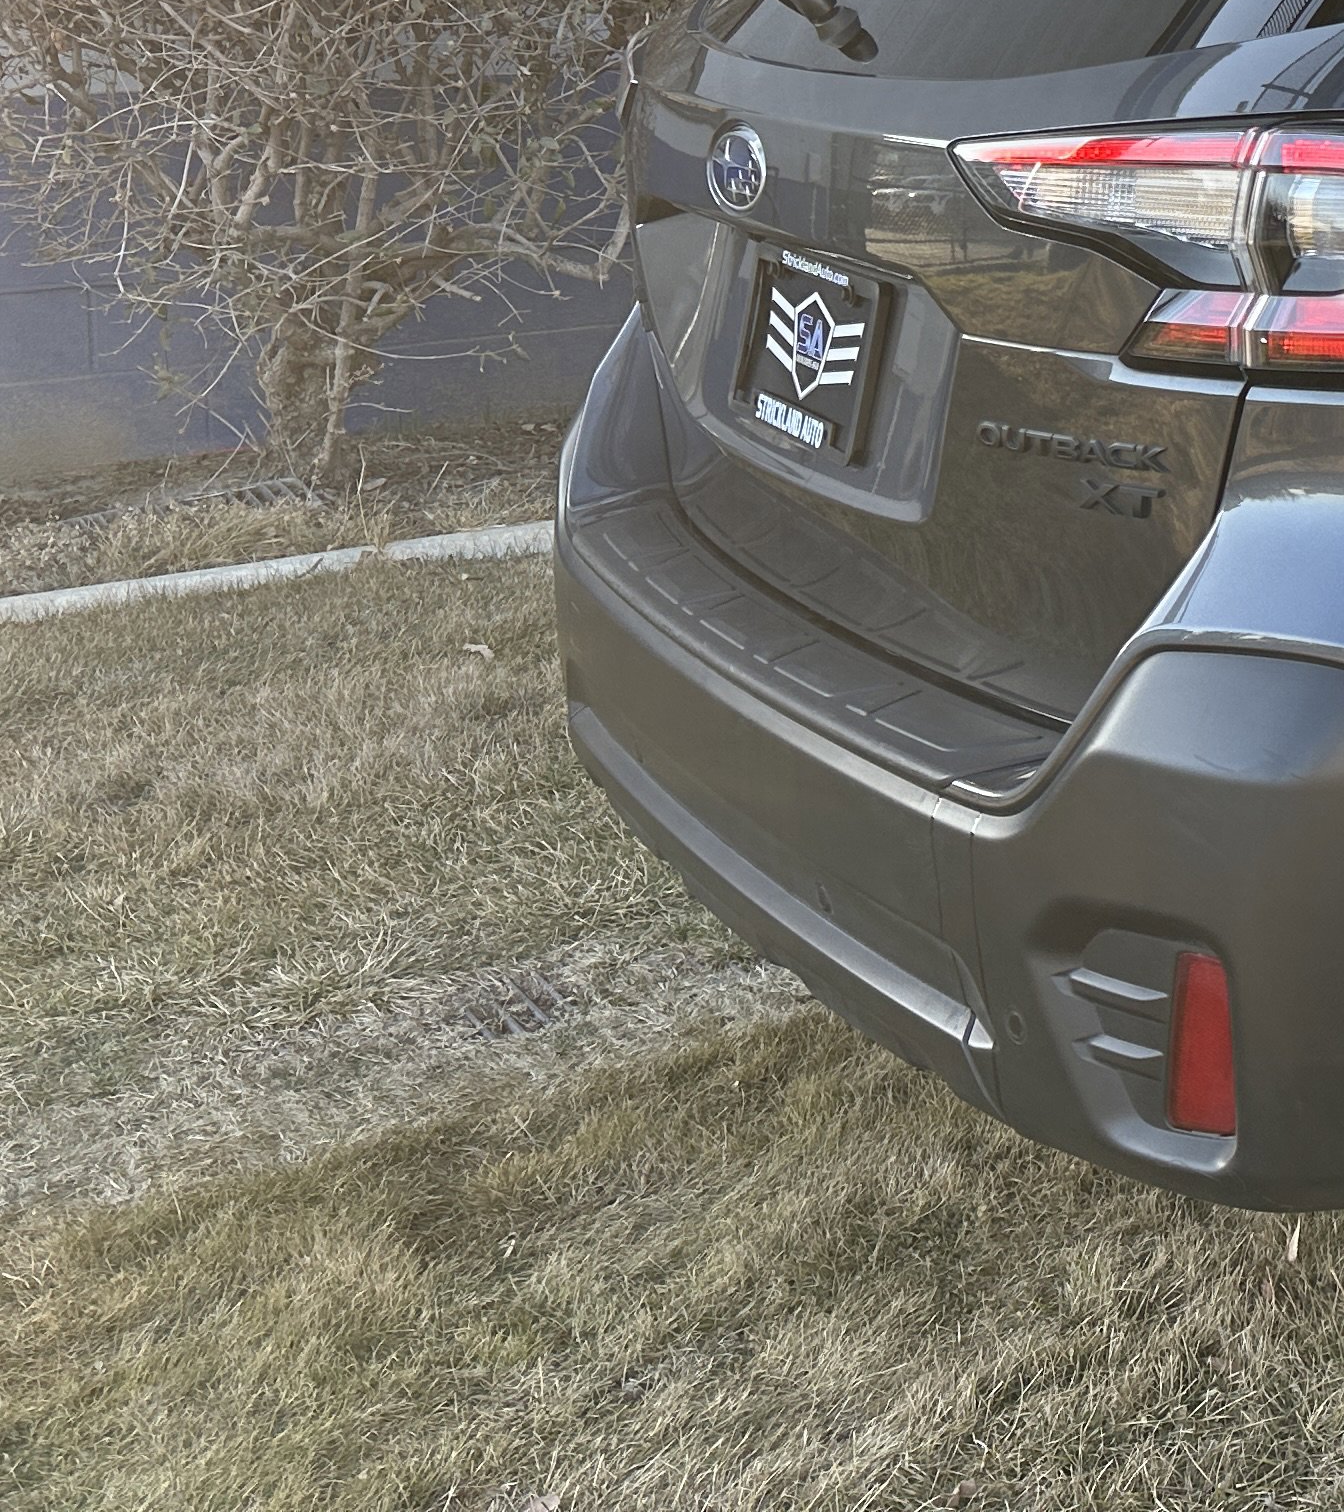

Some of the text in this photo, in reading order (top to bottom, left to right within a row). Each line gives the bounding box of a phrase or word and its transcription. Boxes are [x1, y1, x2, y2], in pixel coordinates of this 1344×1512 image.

[797, 313, 823, 360] SA
[755, 393, 824, 449] STRICKLAND AUTO
[976, 420, 1171, 473] OUTBACK
[1079, 479, 1167, 519] XT
